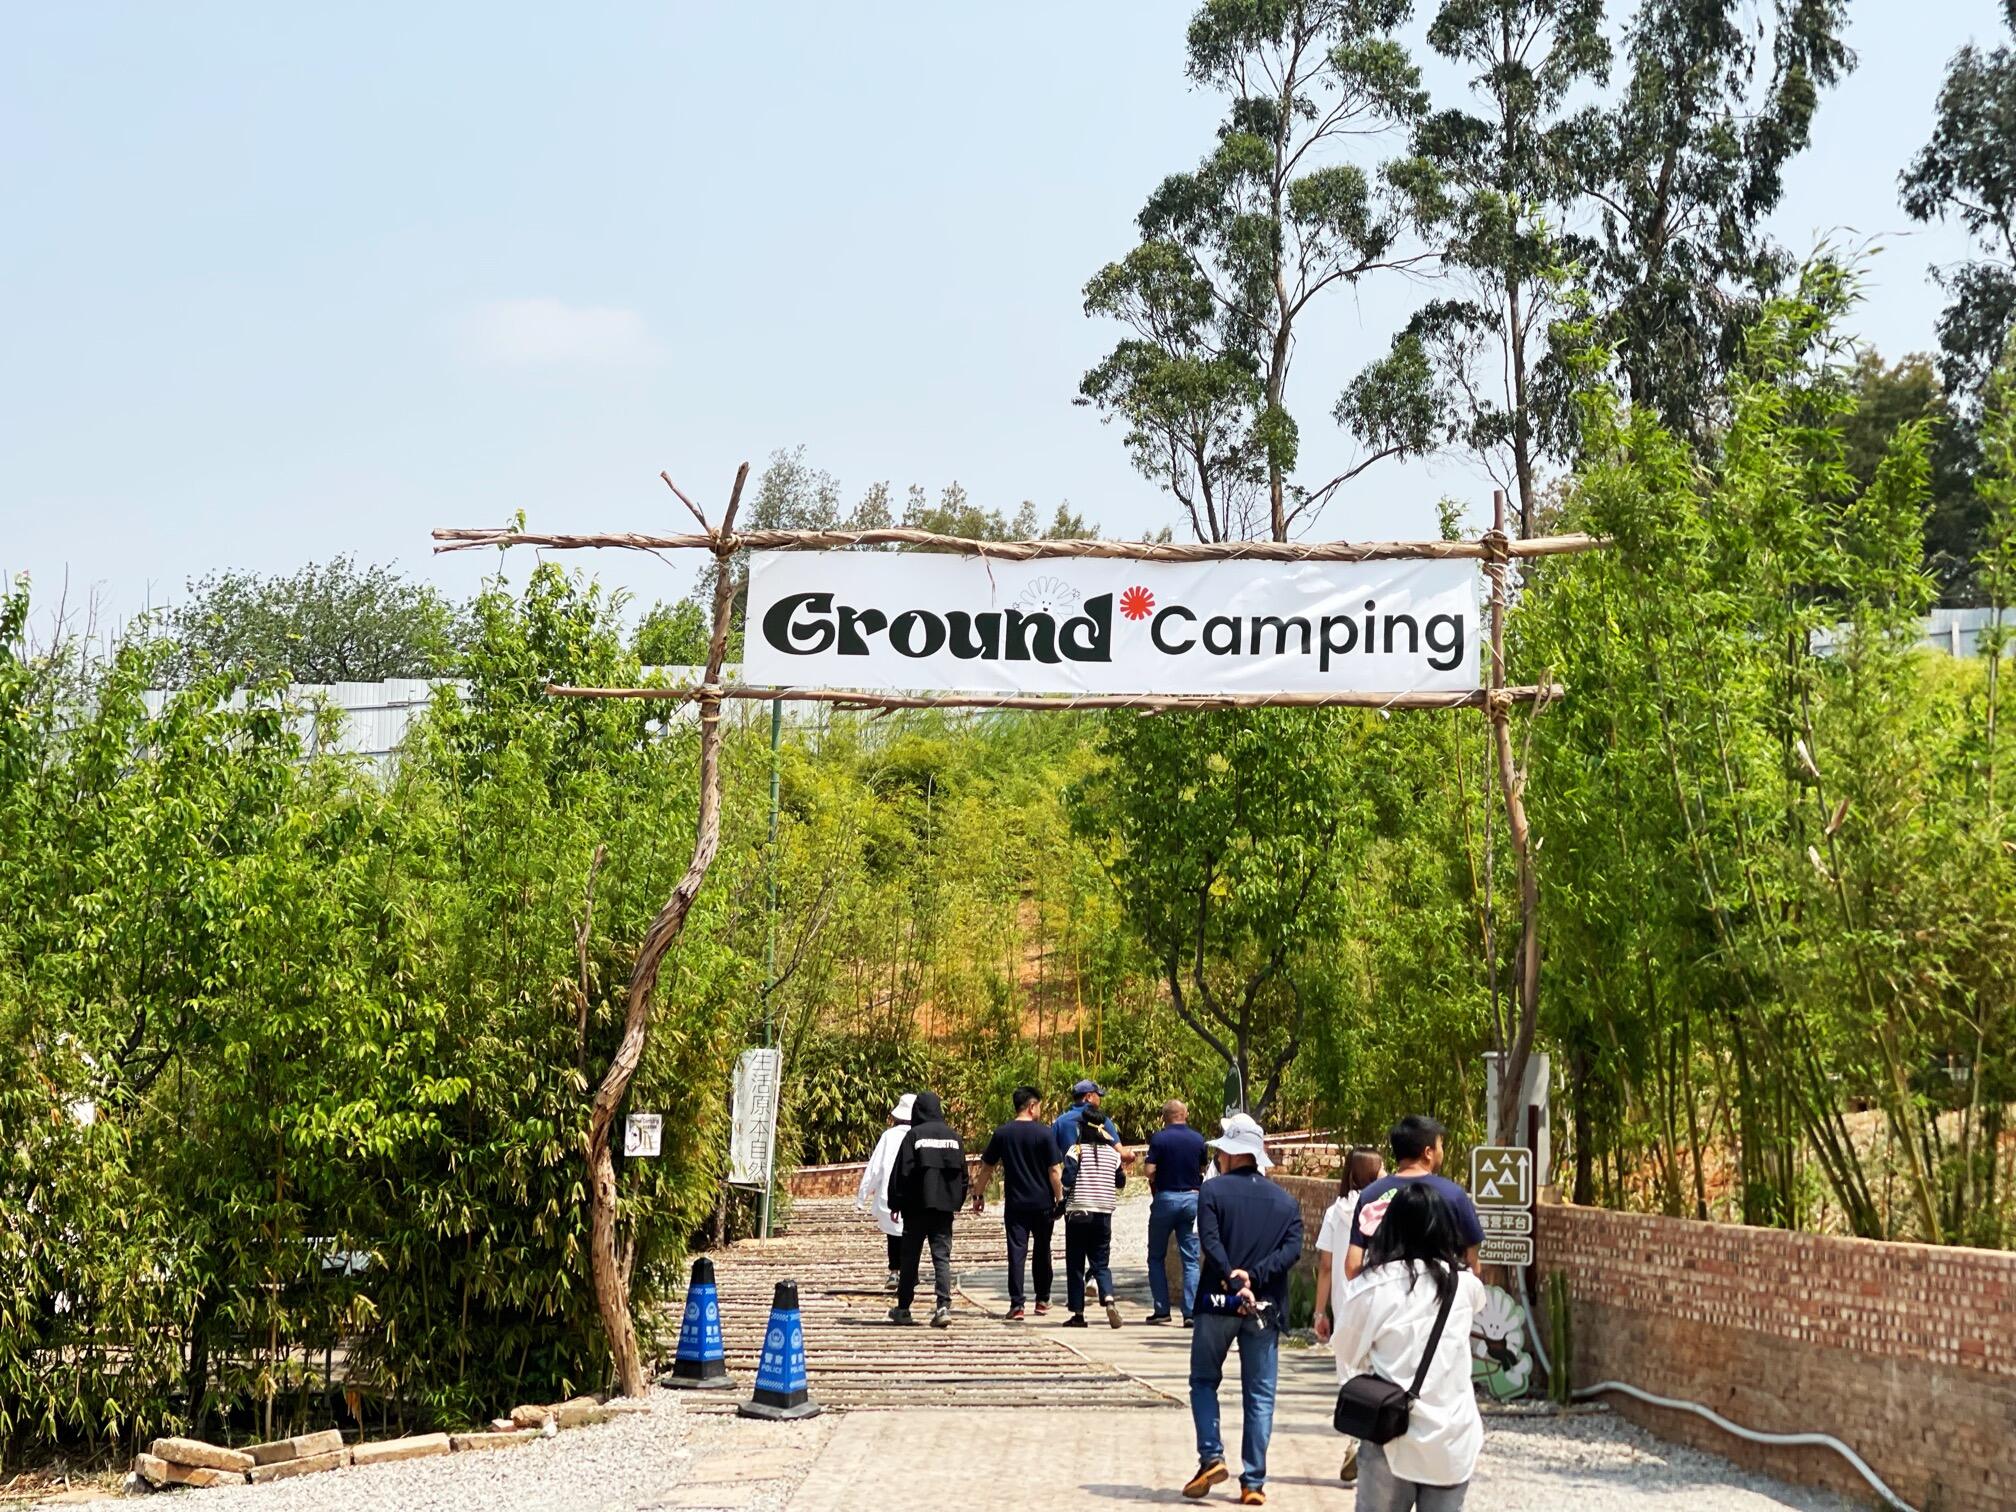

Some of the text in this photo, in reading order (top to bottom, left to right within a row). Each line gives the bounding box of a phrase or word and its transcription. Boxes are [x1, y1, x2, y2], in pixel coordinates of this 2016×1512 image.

[762, 592, 1464, 672] Ground Camping
[749, 1051, 771, 1181] 生活原本自然
[1481, 1240, 1526, 1250] Platform
[1478, 1249, 1527, 1262] Camping
[762, 1364, 783, 1375] POLICE
